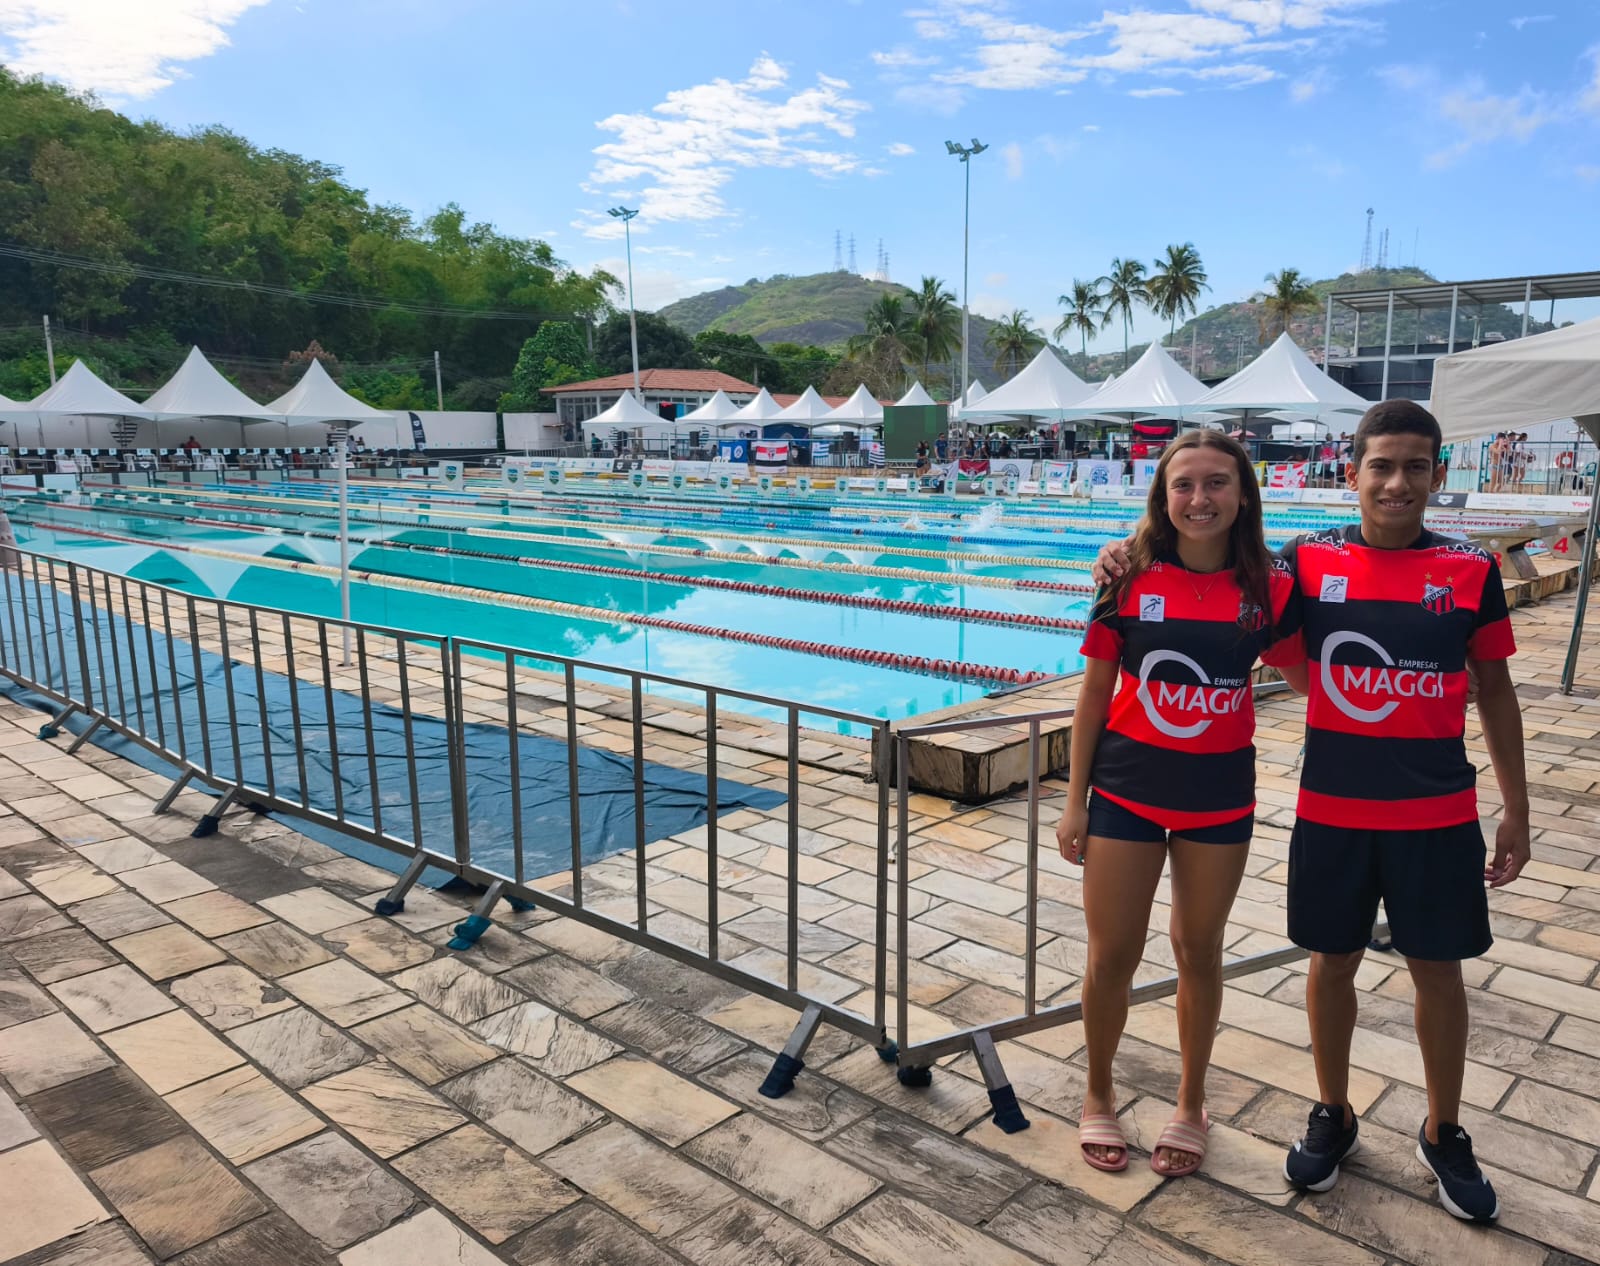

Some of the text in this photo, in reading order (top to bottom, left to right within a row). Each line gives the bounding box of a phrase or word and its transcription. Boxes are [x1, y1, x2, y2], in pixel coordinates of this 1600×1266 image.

[1436, 544, 1488, 557] LAZA
[1553, 536, 1569, 554] 4
[1434, 551, 1474, 561] SHOPPING
[1424, 587, 1450, 604] ITUANO
[1398, 659, 1440, 670] EMPRESAS
[1343, 664, 1444, 698] MAGGI
